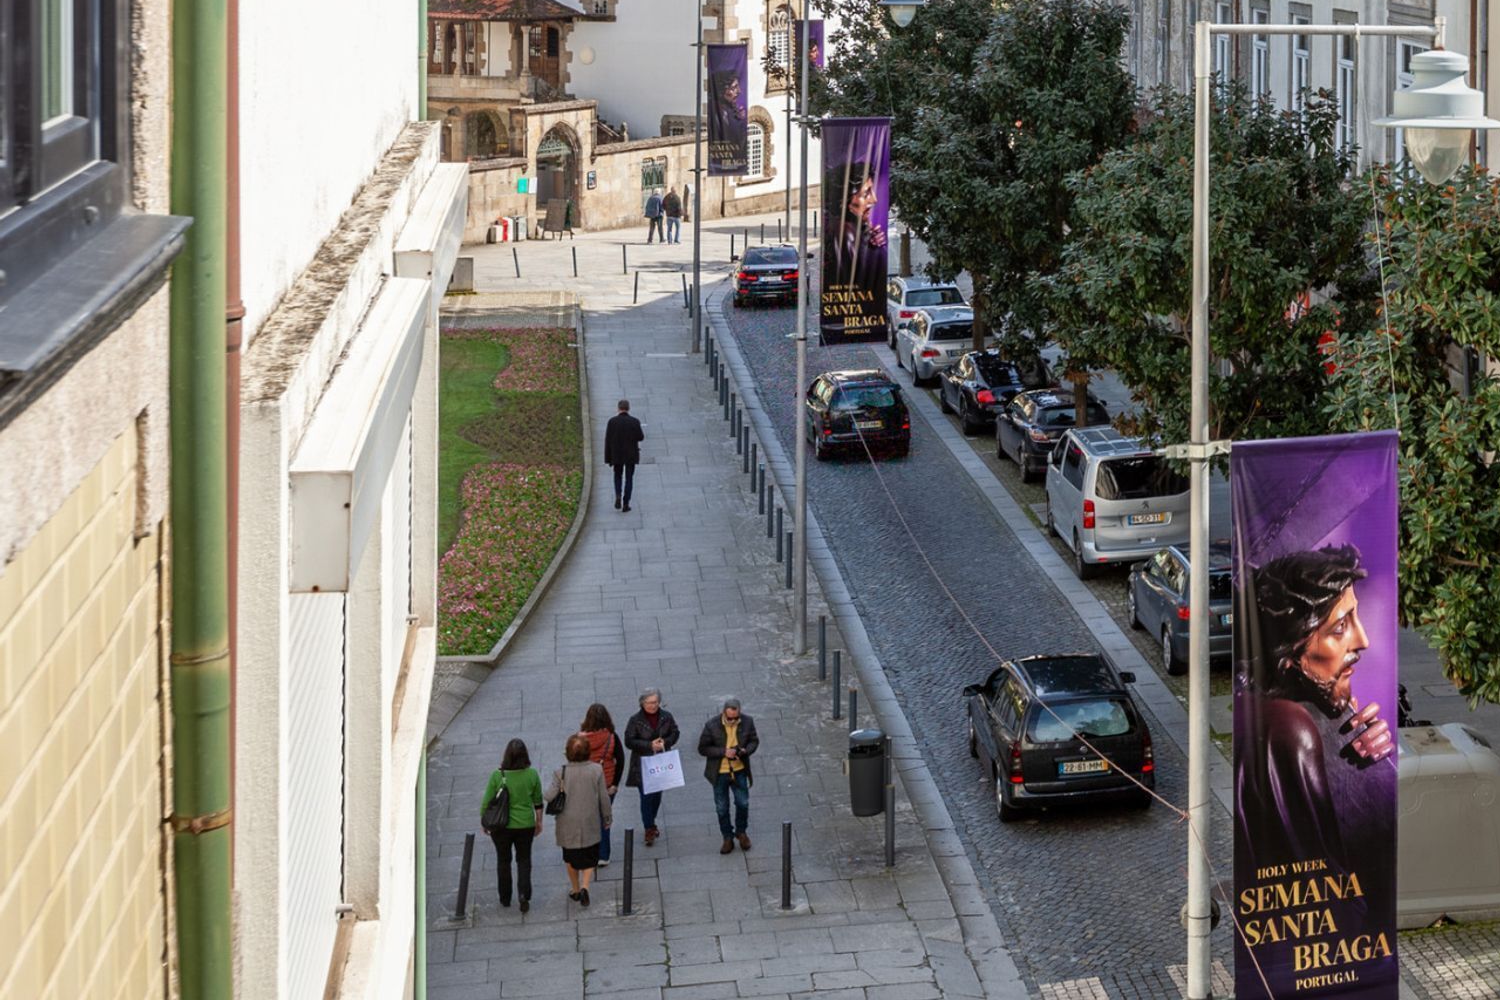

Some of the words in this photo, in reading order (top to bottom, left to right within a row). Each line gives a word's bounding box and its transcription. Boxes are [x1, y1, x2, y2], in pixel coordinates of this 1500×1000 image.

[822, 290, 874, 303] SEMANA
[823, 304, 863, 316] SANTA
[844, 315, 886, 327] BRAGA
[1257, 863, 1289, 880] HOLY
[1292, 858, 1328, 873] WEEK
[1240, 872, 1364, 915] SEMANA
[1244, 908, 1339, 947] SANTA
[1293, 932, 1393, 972] BRAGA
[1295, 970, 1359, 991] PORTUGAL
